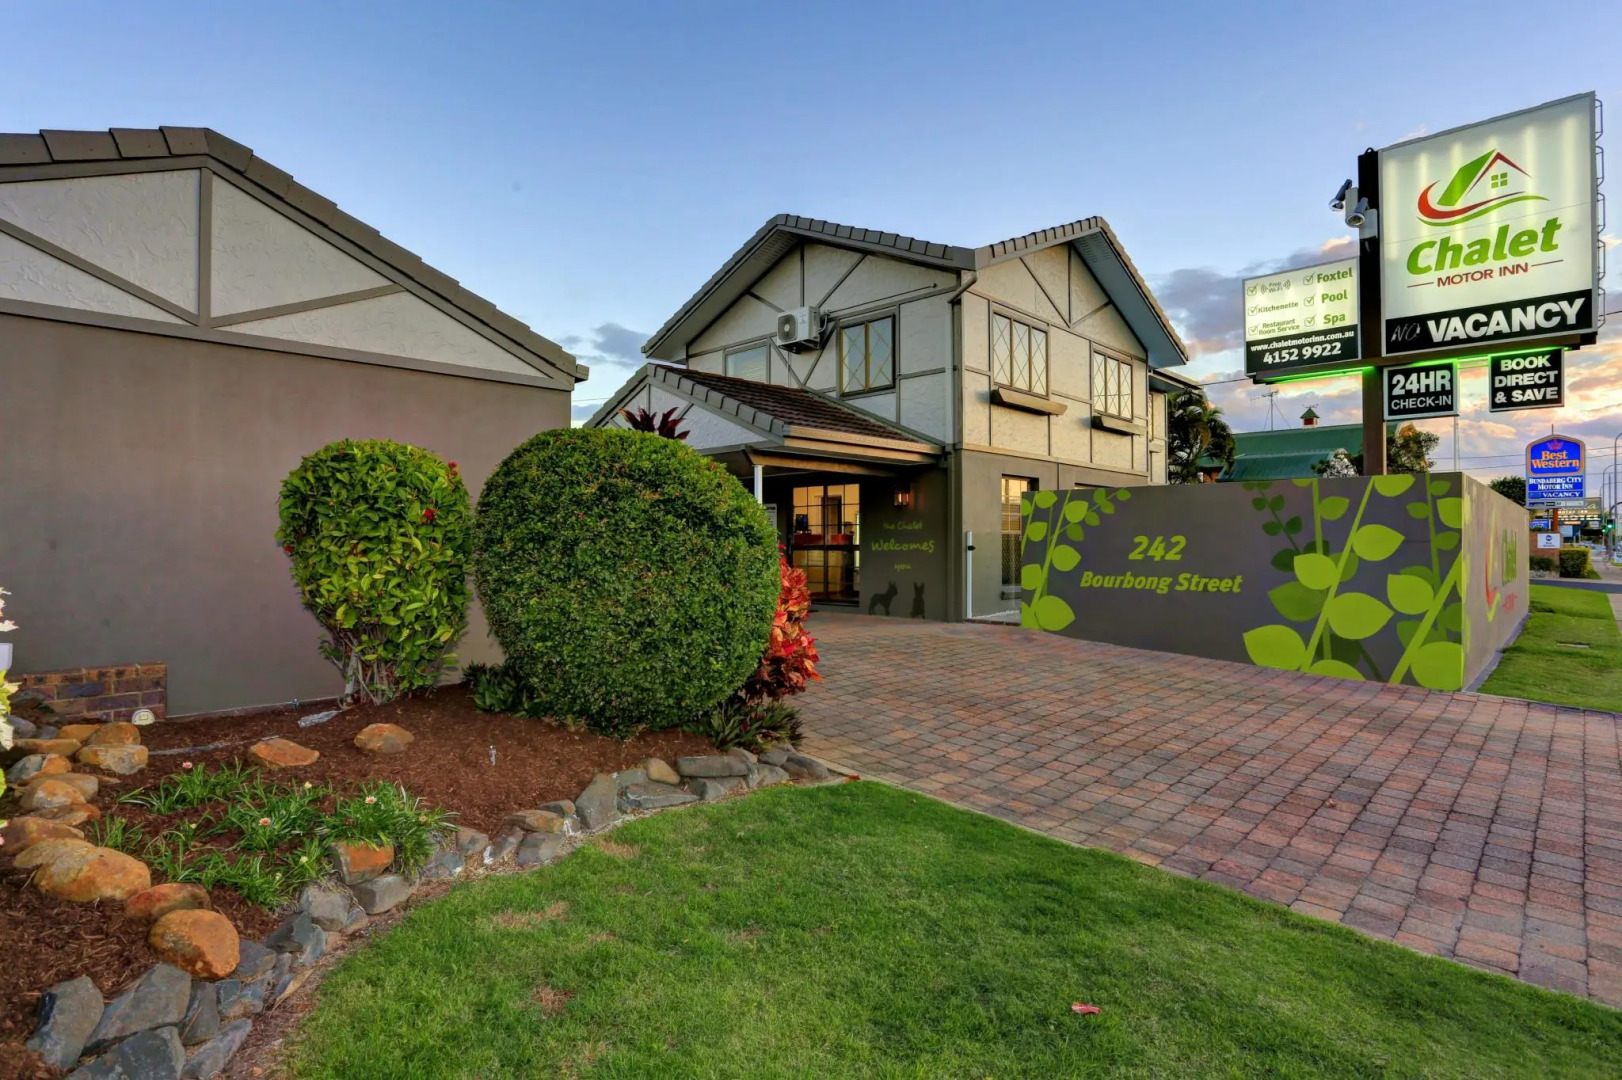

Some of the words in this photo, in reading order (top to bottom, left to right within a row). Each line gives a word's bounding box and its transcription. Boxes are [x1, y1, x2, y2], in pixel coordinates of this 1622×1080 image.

[1407, 217, 1562, 275] Chalet
[1316, 267, 1353, 284] Foxtel
[1437, 269, 1494, 287] MOTOR
[1498, 262, 1529, 277] INN
[1321, 289, 1348, 304] Pool
[1258, 302, 1299, 313] Kitchenette
[1262, 318, 1296, 329] Restaurant
[1323, 313, 1346, 326] Spa
[1427, 298, 1586, 343] VACANCY
[1258, 328, 1276, 336] Room
[1277, 324, 1300, 333] Service
[1250, 330, 1355, 352] www.chaletmotorinn.com.au
[1263, 348, 1299, 364] 4152
[1302, 342, 1342, 360] 9922
[1500, 355, 1552, 372] BOOK
[1391, 370, 1451, 396] 24HR
[1494, 370, 1559, 388] DIRECT
[1391, 394, 1452, 410] CHECK-IN
[1494, 391, 1508, 404] &
[1511, 387, 1559, 402] SAVE
[1541, 450, 1568, 460] Best
[1531, 459, 1580, 469] Western
[871, 538, 935, 553] Welcomes
[1127, 535, 1187, 562] 242
[1080, 571, 1173, 594] Bourbong
[1174, 572, 1243, 593] Street
